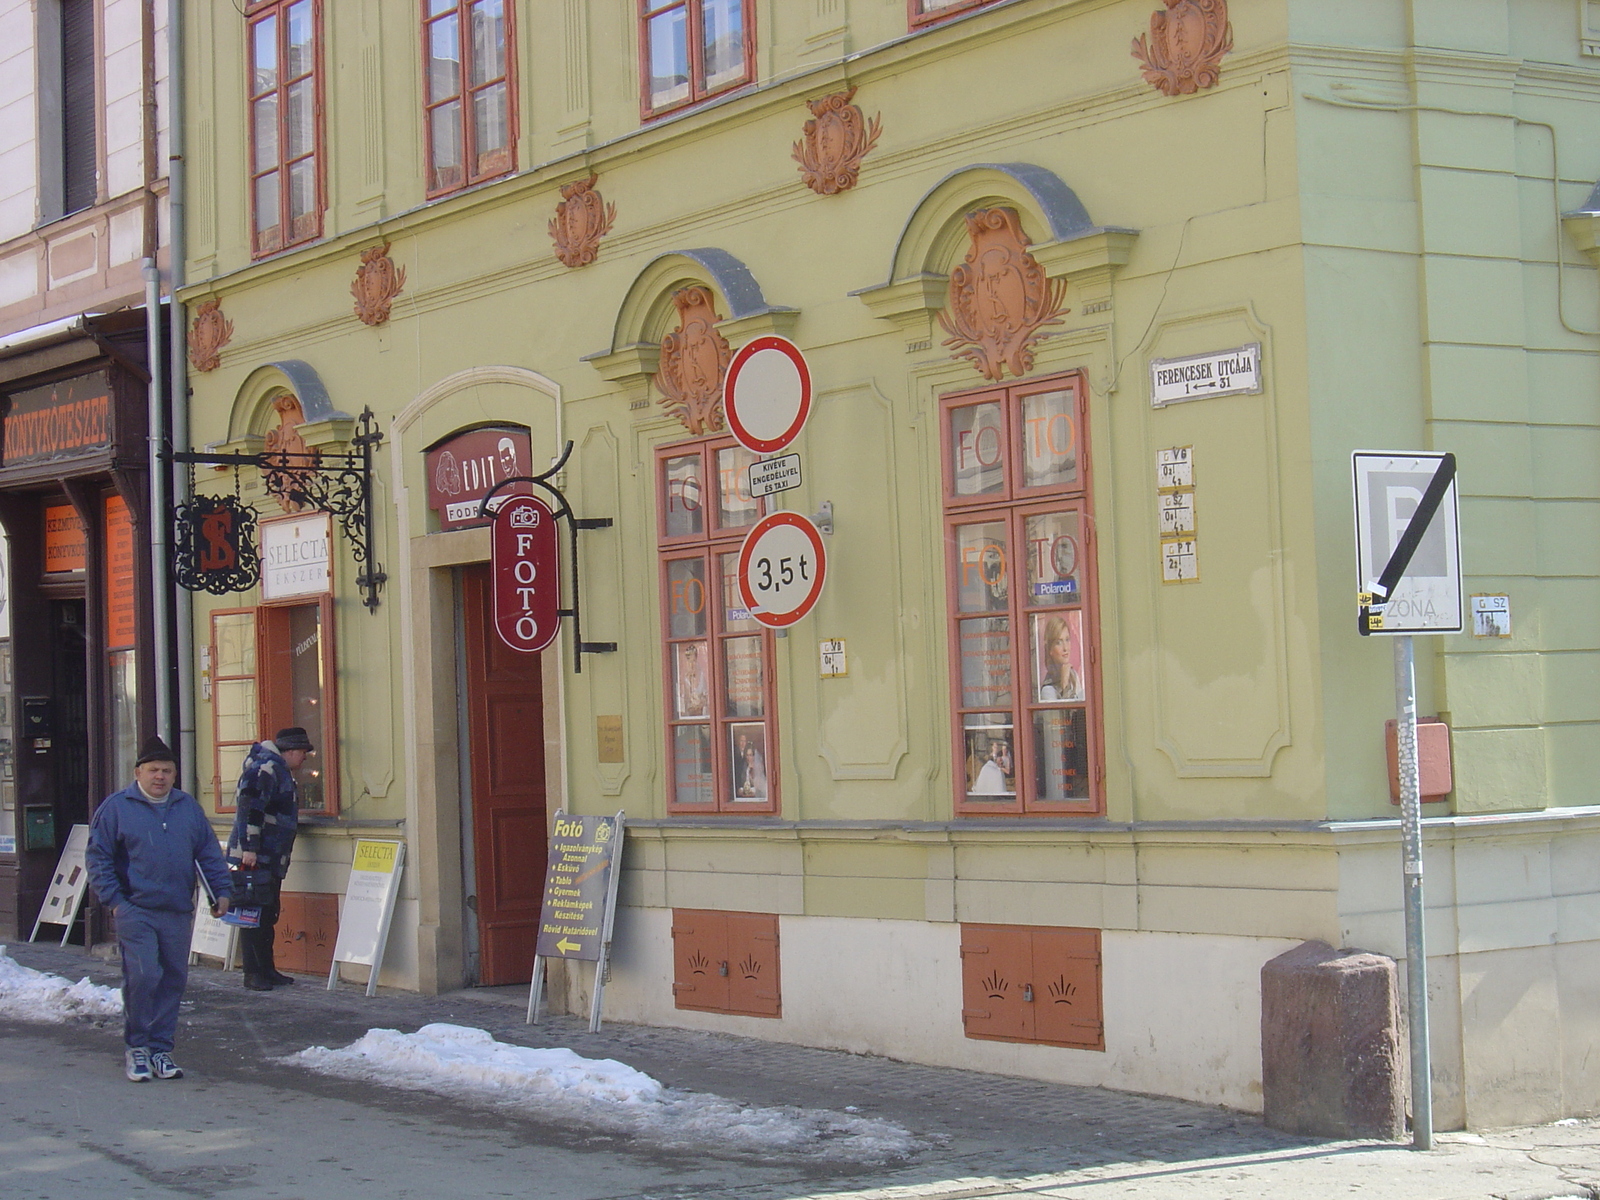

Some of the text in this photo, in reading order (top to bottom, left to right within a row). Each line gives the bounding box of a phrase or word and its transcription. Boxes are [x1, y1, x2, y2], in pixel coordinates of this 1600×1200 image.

[1157, 353, 1253, 387] FERENCESEK UTCÁJA
[1185, 376, 1231, 394] 1 31
[4, 387, 108, 460] KÖNYVKÖTÉSZET
[958, 413, 1076, 470] FO TO
[462, 456, 496, 491] EDIT
[763, 459, 786, 472] KIVÉVE
[753, 468, 798, 485] ENGEDÉLLYEL
[669, 476, 702, 513] FO
[765, 481, 788, 492] ÉS TAXI
[449, 502, 502, 519] FODRS
[269, 538, 328, 566] SELECTA
[961, 535, 1079, 586] FO TO
[757, 554, 809, 592] 3,5 t
[514, 534, 538, 640] FOTÓ
[1040, 582, 1071, 594] Polaroid
[671, 578, 705, 614] FO
[1493, 597, 1506, 608] SZ
[1387, 600, 1436, 617] ZONA
[554, 819, 583, 838] Fotó
[359, 846, 393, 860] SELECTA
[559, 843, 603, 855] Igazolványkép
[562, 853, 588, 863] Azonnal
[555, 875, 572, 885] Tabló
[554, 886, 581, 898] Gyermek
[552, 898, 593, 911] Reklámképek
